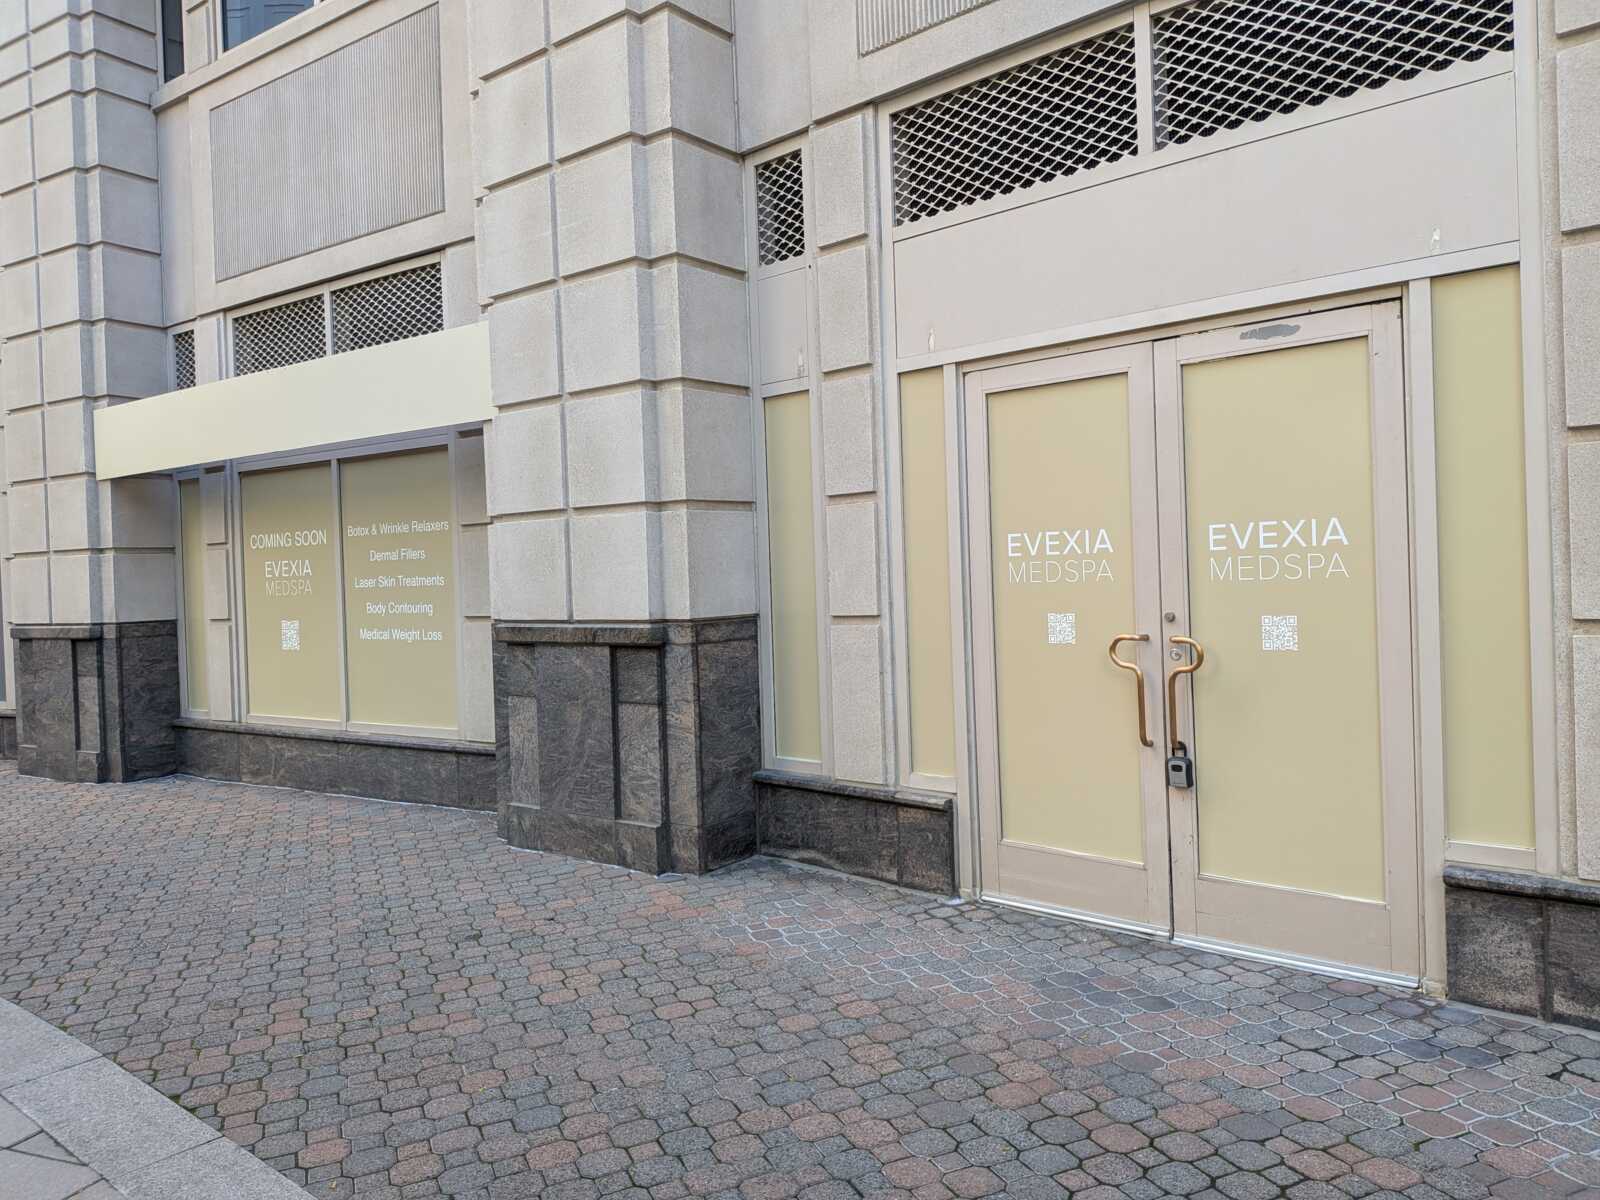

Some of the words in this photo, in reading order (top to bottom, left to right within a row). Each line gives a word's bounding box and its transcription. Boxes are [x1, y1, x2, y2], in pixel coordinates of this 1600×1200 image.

[348, 525, 370, 537] Botox
[371, 524, 377, 535] &
[380, 521, 409, 535] Wrinkle
[412, 520, 449, 532] Relaxers
[1208, 517, 1349, 551] EVEXIA
[250, 531, 292, 549] COMING
[294, 529, 327, 546] SOON
[1007, 528, 1114, 557] EVEXIA
[370, 549, 398, 562] Dermal
[401, 547, 426, 559] Fillers
[265, 559, 312, 578] EVEXIA
[1008, 559, 1114, 583] MEDSPA
[1209, 552, 1350, 582] MEDSPA
[265, 579, 312, 597] MEDSPA
[354, 577, 376, 589] Laser
[378, 575, 396, 588] Skin
[397, 574, 445, 587] Treatments
[366, 602, 387, 615] Body
[388, 602, 433, 616] Contouring
[360, 628, 390, 641] Medical
[391, 628, 420, 643] Weight
[422, 629, 442, 641] Loss
